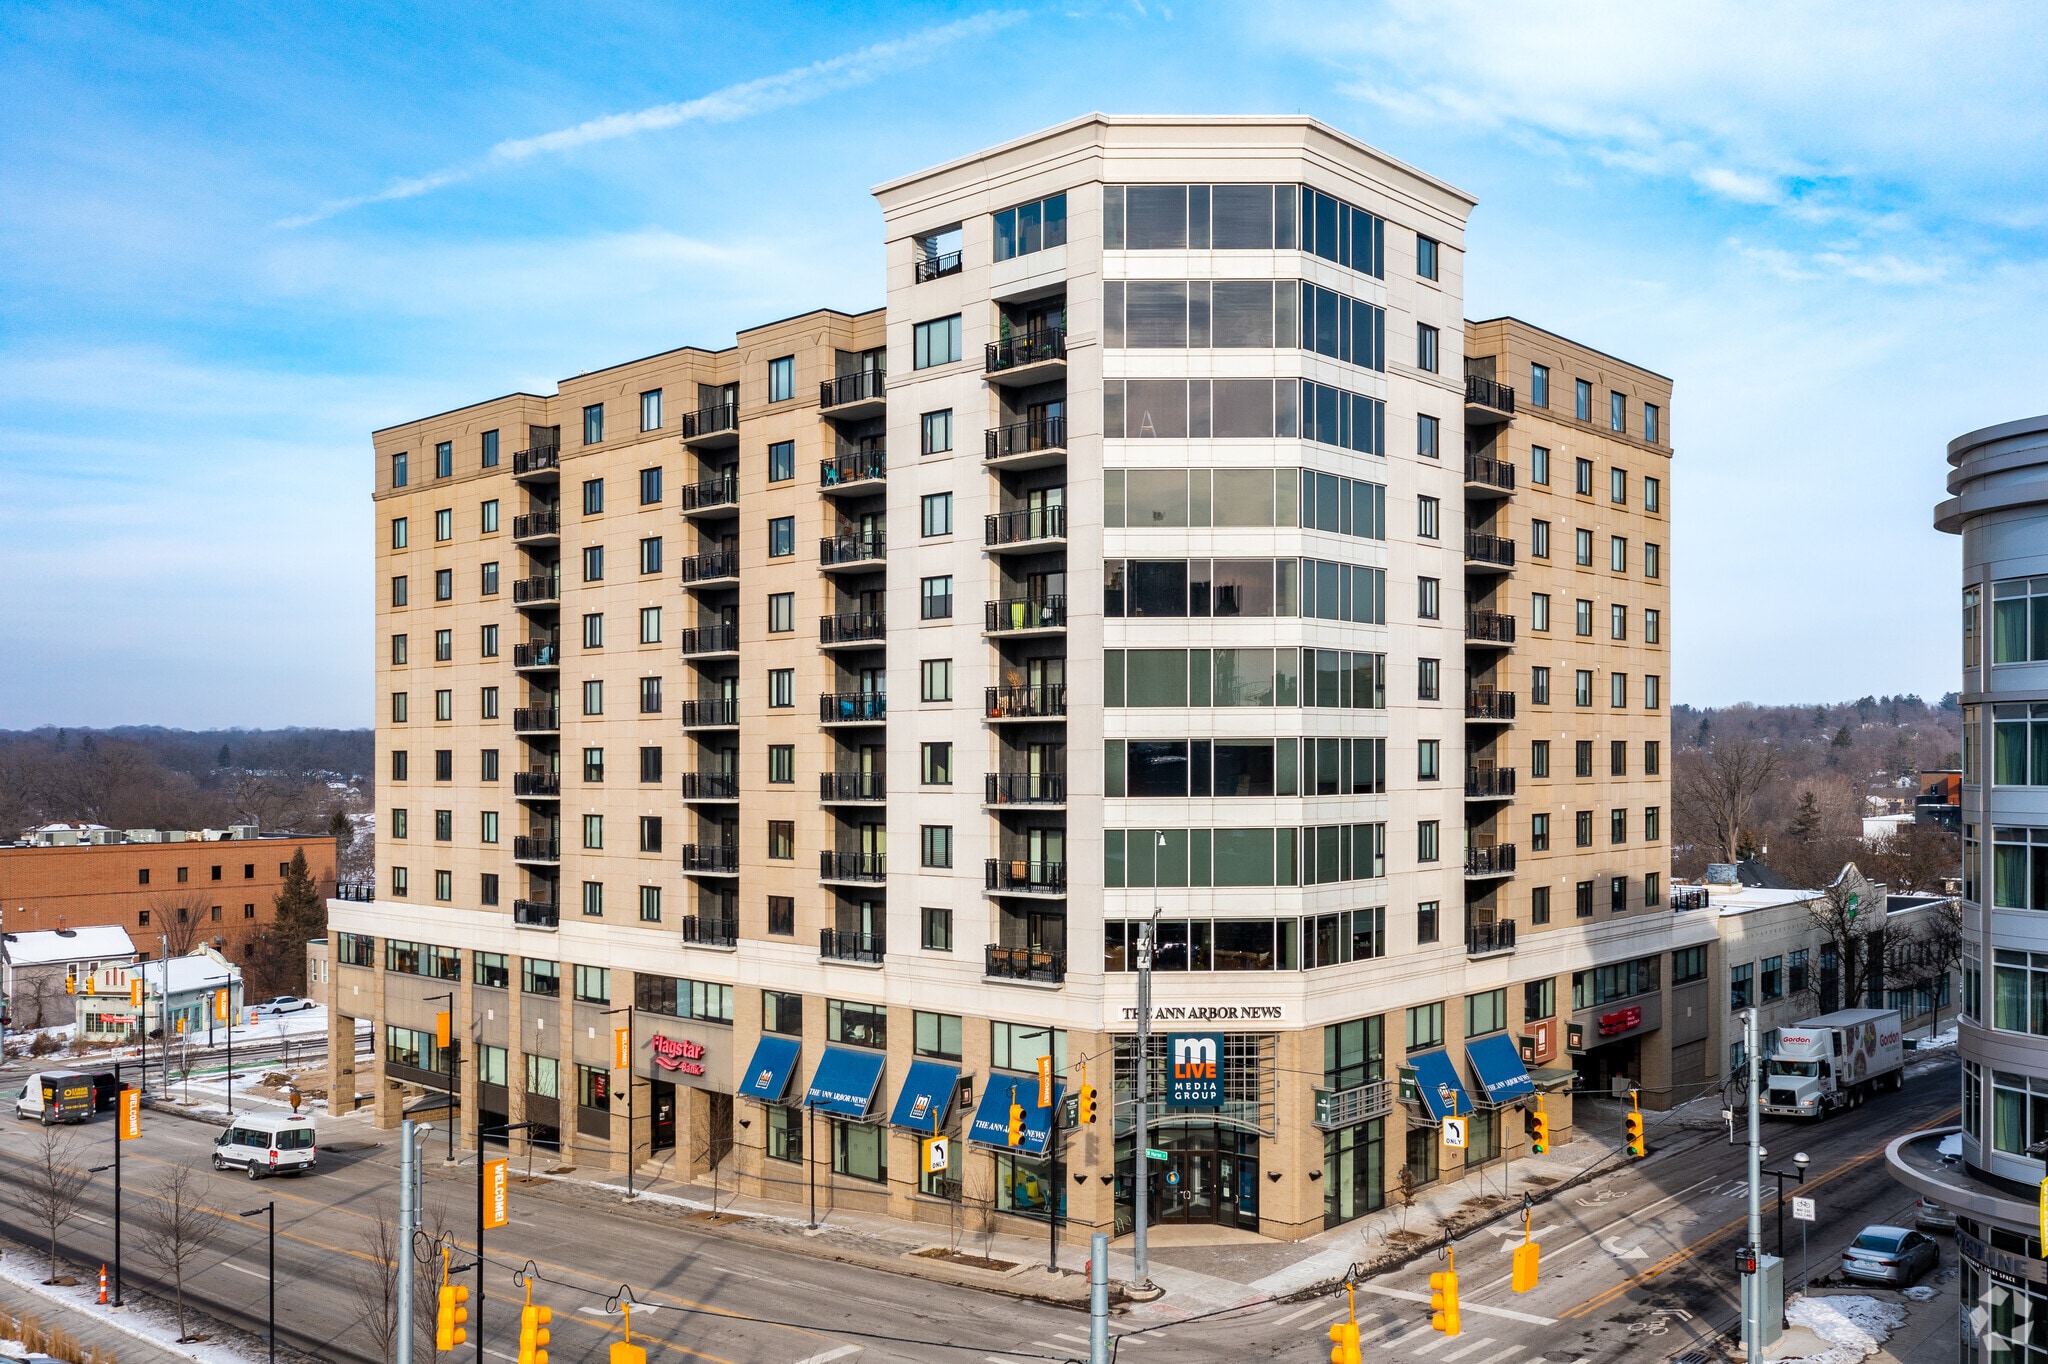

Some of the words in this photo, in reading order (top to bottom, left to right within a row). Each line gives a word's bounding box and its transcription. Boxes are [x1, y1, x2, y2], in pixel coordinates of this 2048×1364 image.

[1155, 1007, 1185, 1019] ANN
[1188, 1007, 1238, 1022] ARBOR
[1241, 1007, 1282, 1019] NEWS
[652, 1034, 705, 1060] Flagstar
[1880, 1031, 1900, 1047] Gordon
[681, 1061, 705, 1076] Bank
[1174, 1063, 1217, 1079] LIVE
[1174, 1082, 1217, 1090] MEDIA
[809, 1087, 821, 1097] THE
[834, 1092, 851, 1102] ARBOR
[851, 1095, 868, 1105] NEWS
[1174, 1091, 1217, 1100] GROUP
[129, 1092, 138, 1136] WELCOME!
[975, 1120, 989, 1129] THE
[989, 1122, 1003, 1131] ANN
[1026, 1129, 1046, 1140] NEWS
[932, 1160, 945, 1169] ONLY
[494, 1163, 504, 1223] WELCOME!
[1999, 1273, 2016, 1283] SPACE
